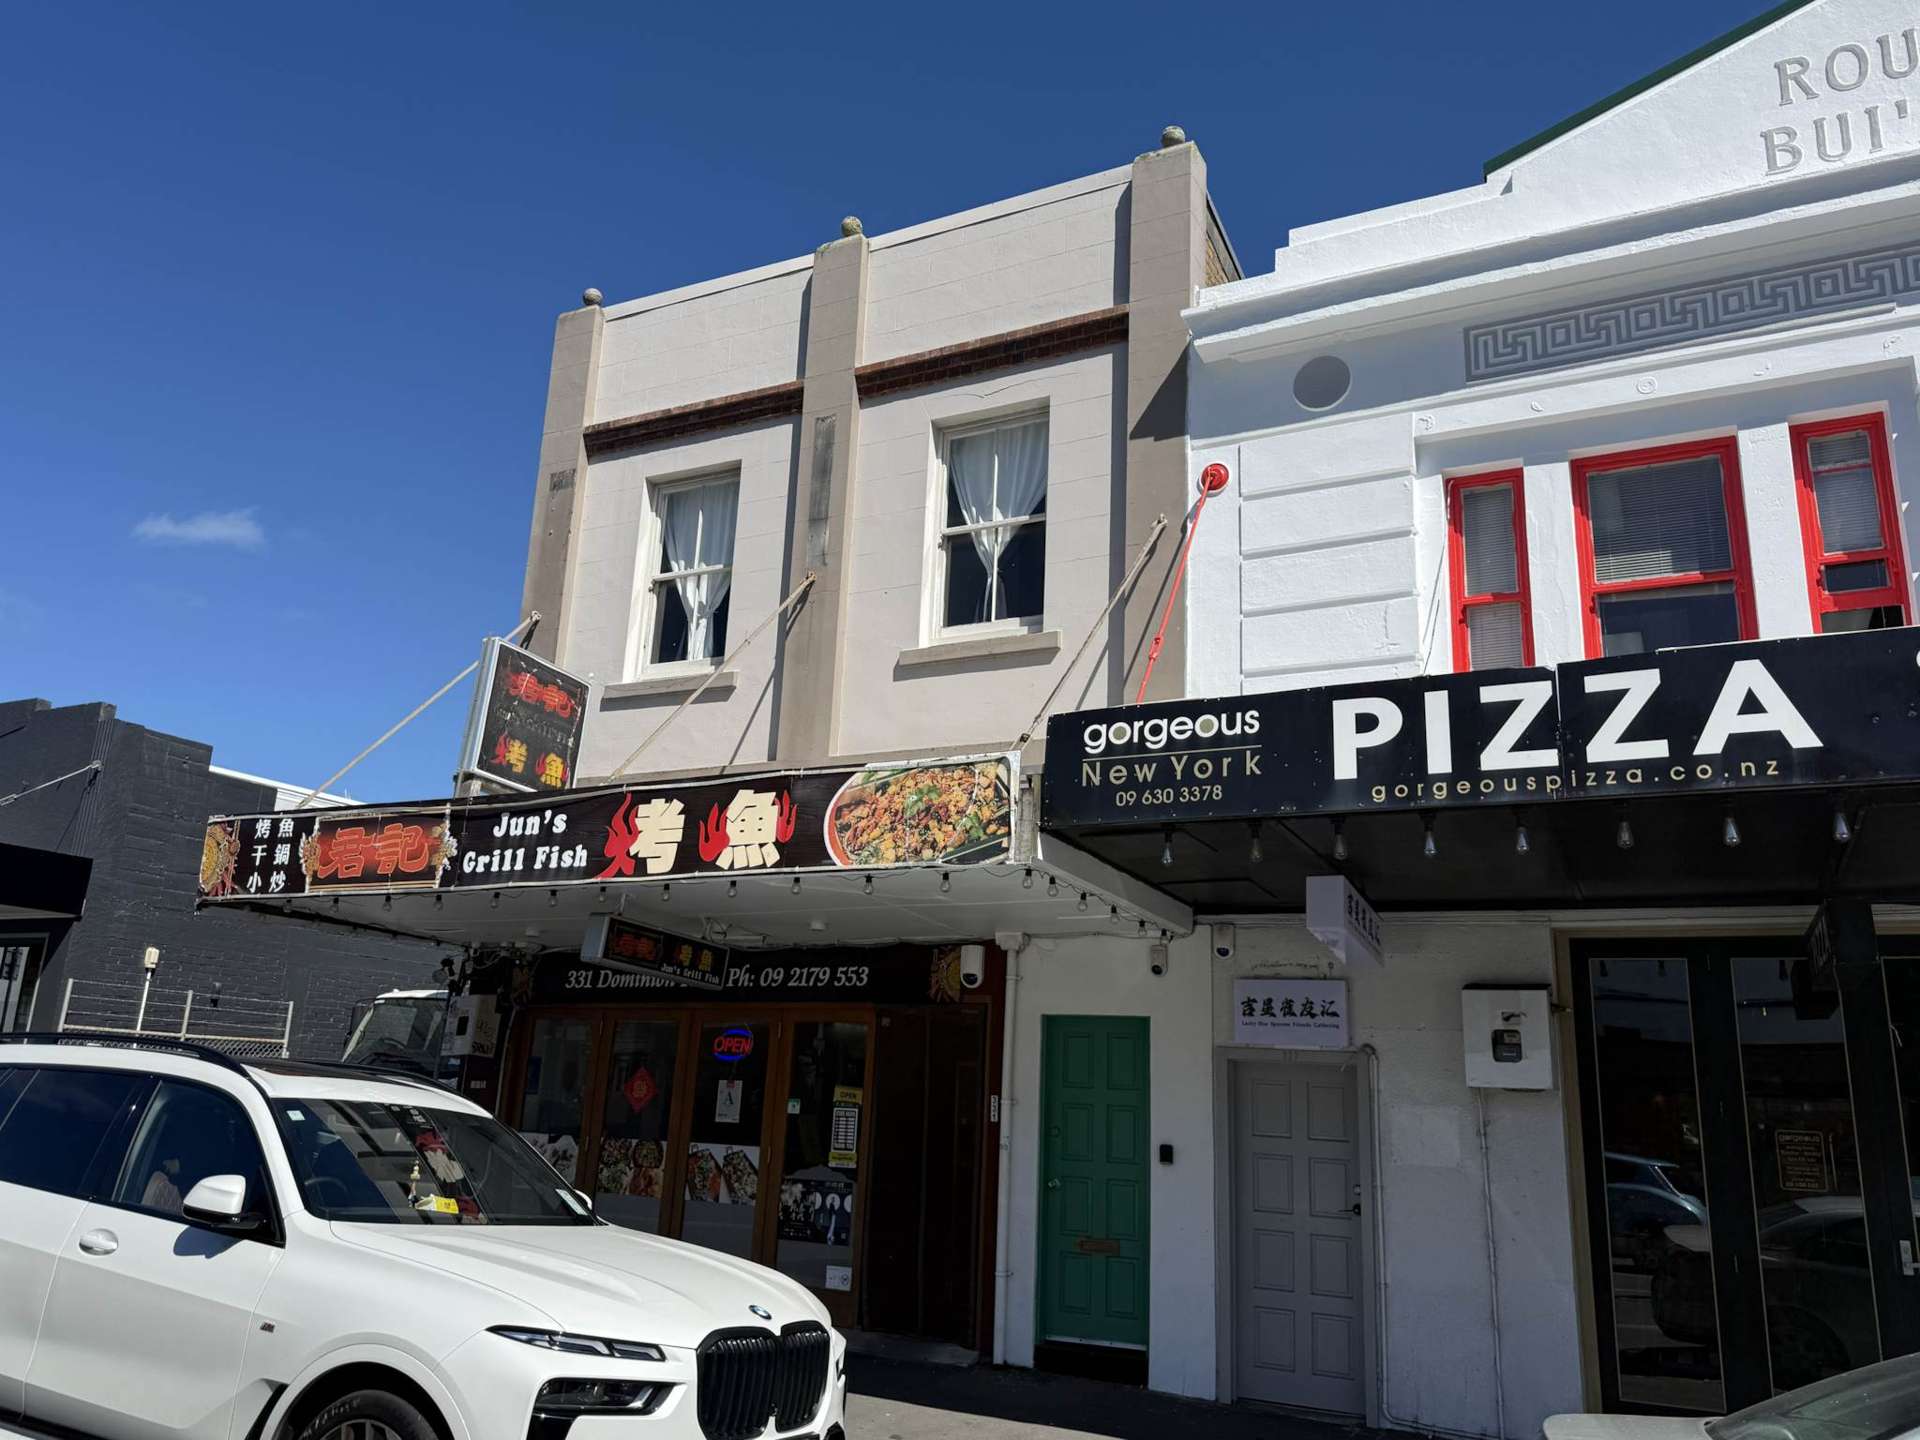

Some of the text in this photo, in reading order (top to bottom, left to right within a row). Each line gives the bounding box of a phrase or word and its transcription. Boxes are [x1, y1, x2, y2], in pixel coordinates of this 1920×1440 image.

[1083, 709, 1260, 755] gorgeous
[1331, 658, 1824, 782] PIZZA
[1082, 750, 1262, 787] New York
[1371, 758, 1780, 804] gorgeouspizza.co.nz
[1115, 784, 1222, 808] 09 630 3378
[492, 809, 568, 838] Jun's
[462, 843, 589, 875] Grill Fish
[565, 969, 593, 989] 331
[726, 964, 756, 988] Ph:
[759, 967, 783, 987] 09
[789, 966, 830, 988] 2179
[833, 965, 869, 987] 553
[713, 1034, 752, 1056] OPEN
